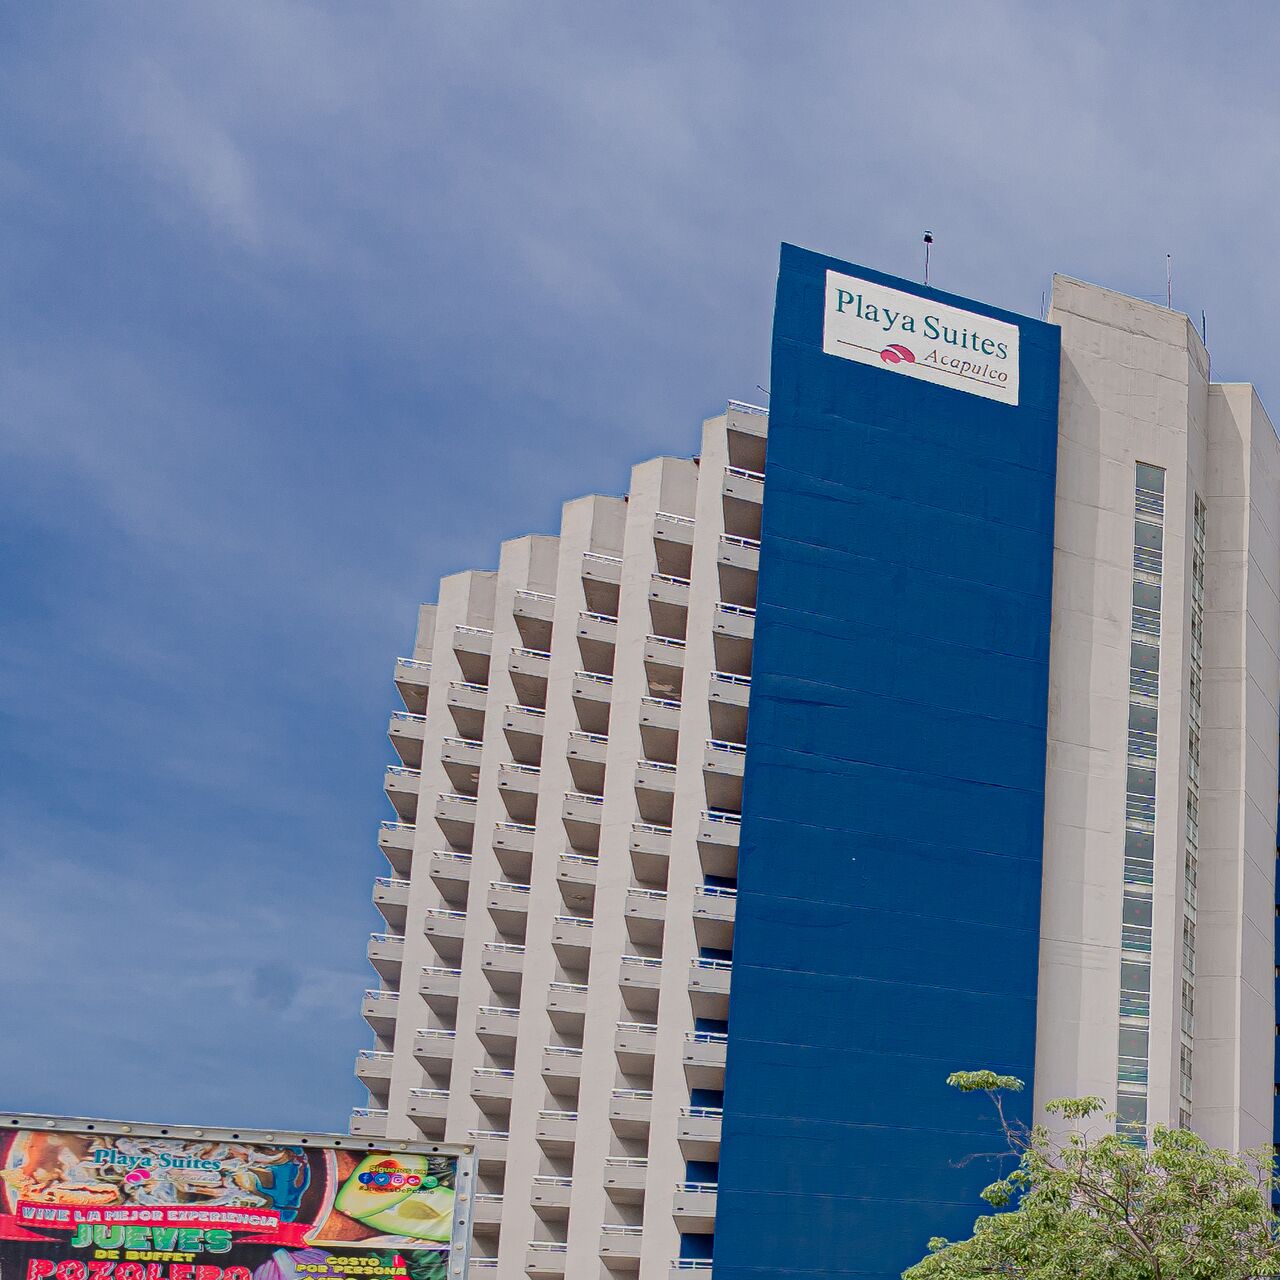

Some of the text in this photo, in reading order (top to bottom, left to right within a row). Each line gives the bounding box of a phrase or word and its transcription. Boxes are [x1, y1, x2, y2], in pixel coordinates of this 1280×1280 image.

[835, 287, 1009, 360] Playa Suites
[924, 349, 1009, 382] Acapulco
[93, 1148, 222, 1171] Playa Suites
[21, 1206, 279, 1228] VIVE LA MEJOR EXPERIENCIA
[71, 1223, 233, 1254] JUEVES
[94, 1249, 196, 1262] DE BUFFET
[325, 1256, 380, 1267] COSTO
[296, 1263, 407, 1276] POR PERSONA
